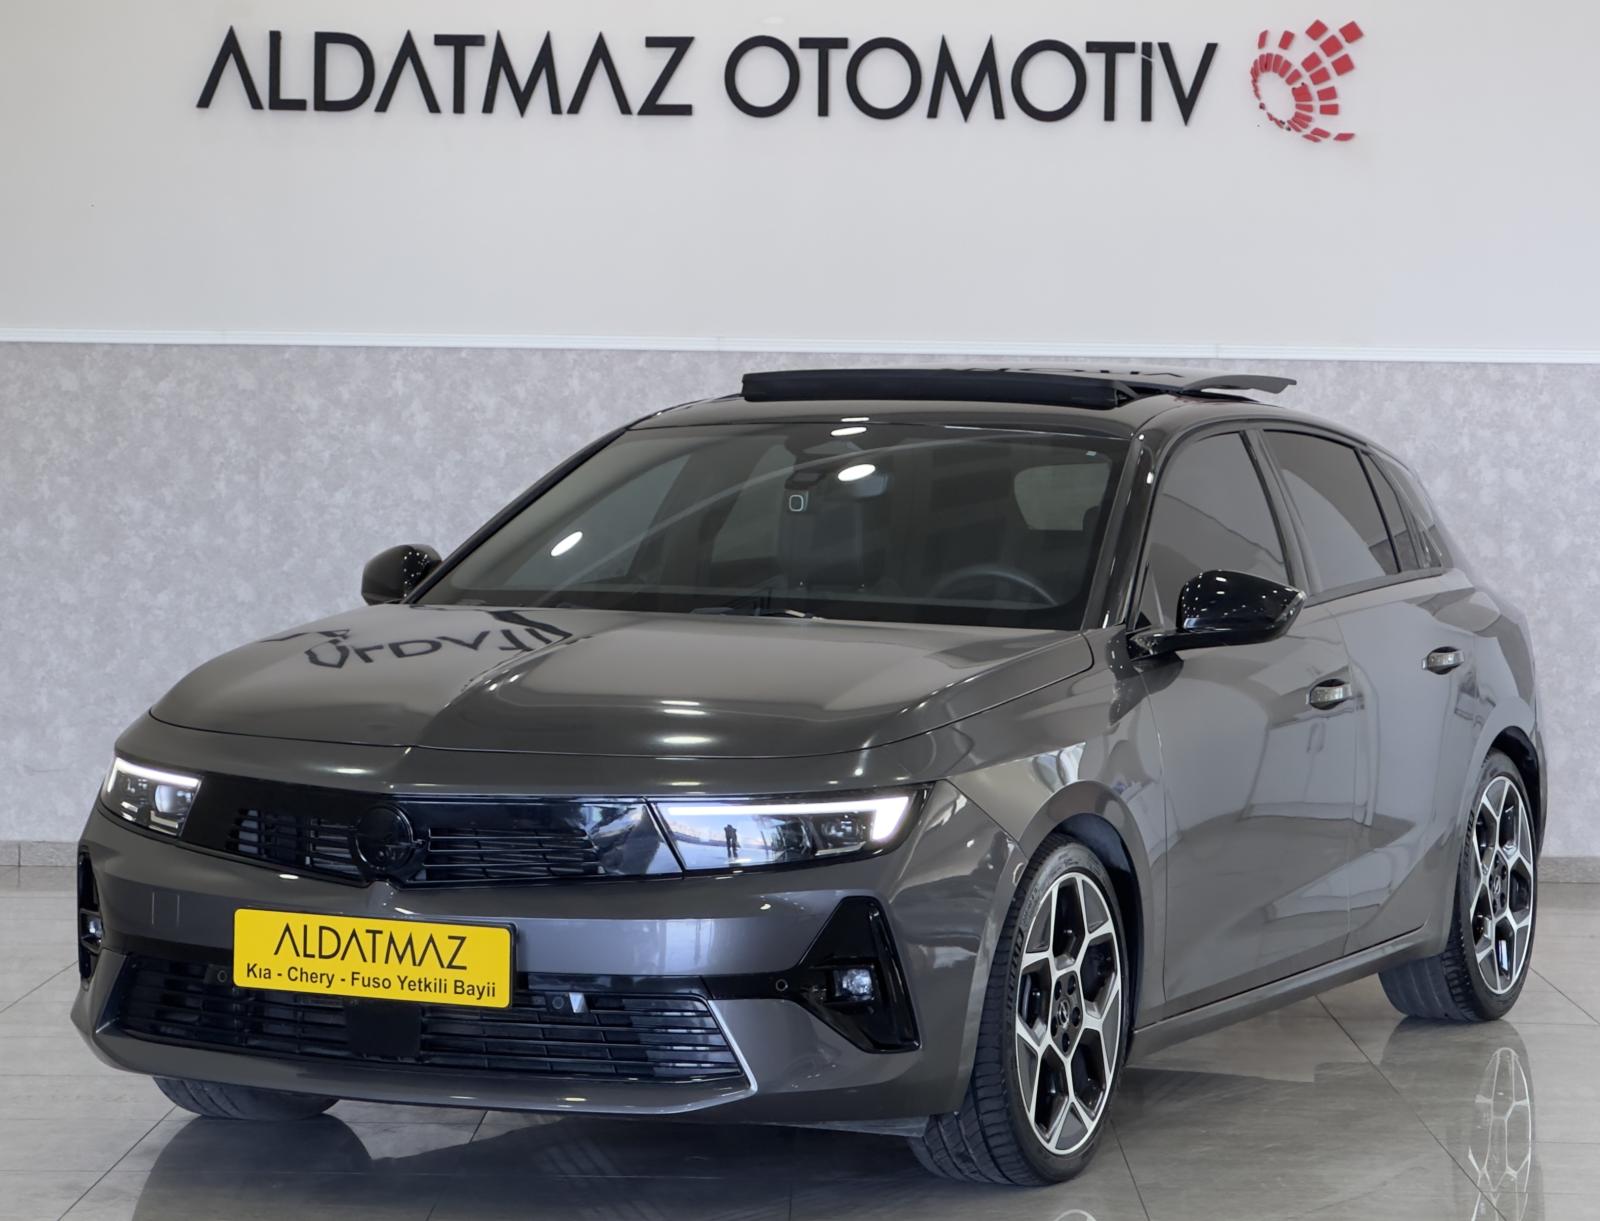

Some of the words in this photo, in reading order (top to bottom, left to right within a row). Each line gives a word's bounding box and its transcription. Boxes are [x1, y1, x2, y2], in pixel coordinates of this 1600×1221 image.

[197, 26, 695, 118] ALDATMAZ
[274, 922, 468, 971] ALDATMAZ
[287, 966, 335, 989] Chery
[351, 971, 392, 990] Fuso
[397, 975, 448, 994] Yetkili
[453, 979, 496, 1001] Bayii
